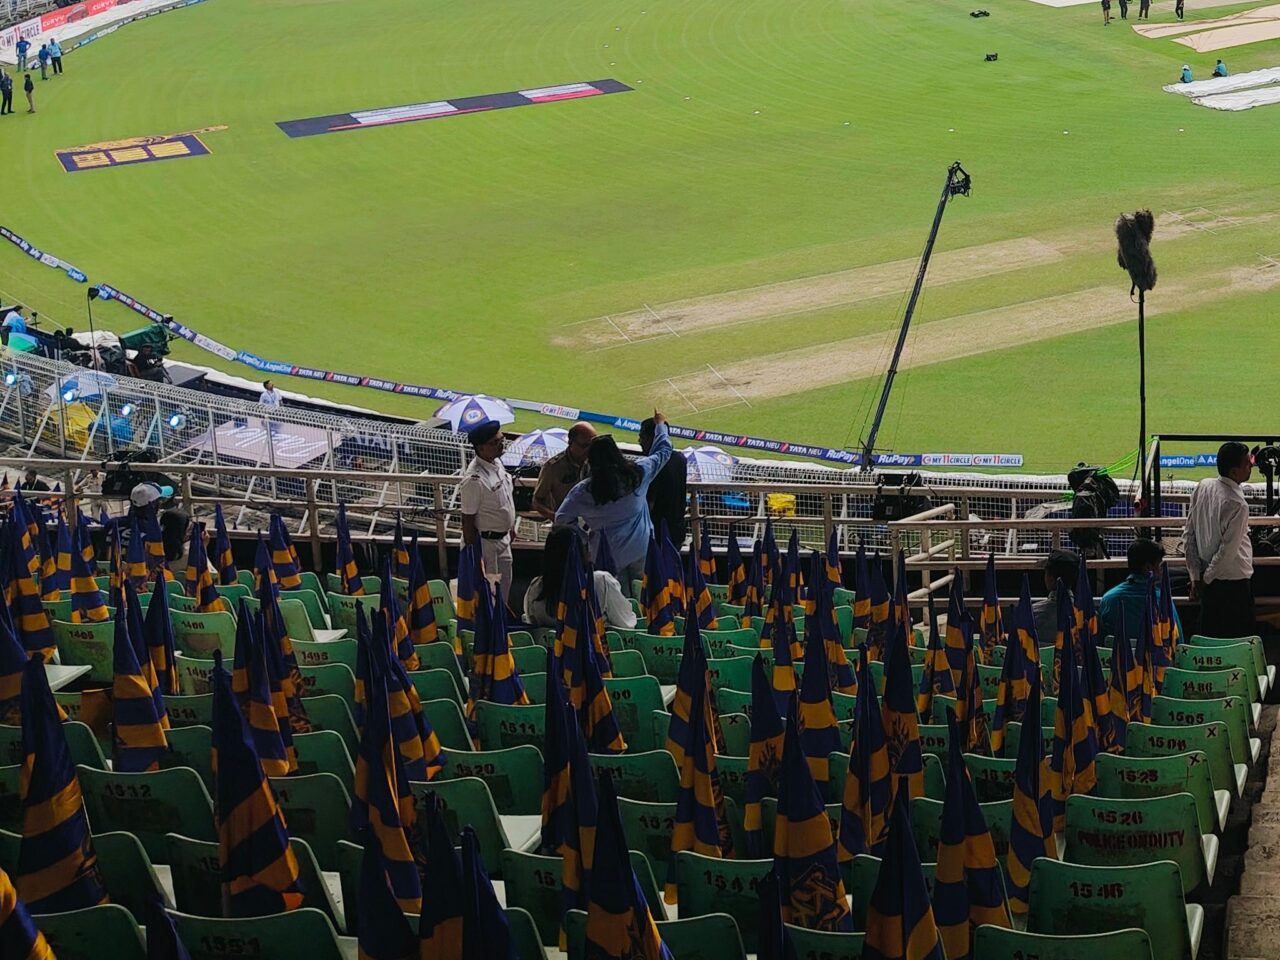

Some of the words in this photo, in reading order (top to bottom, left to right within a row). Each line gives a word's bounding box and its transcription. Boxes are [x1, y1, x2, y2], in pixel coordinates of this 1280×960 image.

[298, 368, 313, 377] TATA
[333, 374, 348, 383] TATA
[368, 379, 383, 388] TATA
[383, 381, 395, 390] NEU
[403, 385, 418, 393] TATA
[418, 386, 431, 395] NEU
[681, 427, 695, 437] NEU
[706, 433, 723, 442] TATA
[723, 435, 738, 443] NEU
[747, 439, 765, 448] TATA
[766, 441, 780, 450] NEU
[788, 445, 806, 454] TATA
[808, 448, 823, 456] NEU
[825, 449, 854, 462] RuPay
[878, 454, 909, 465] RuPay
